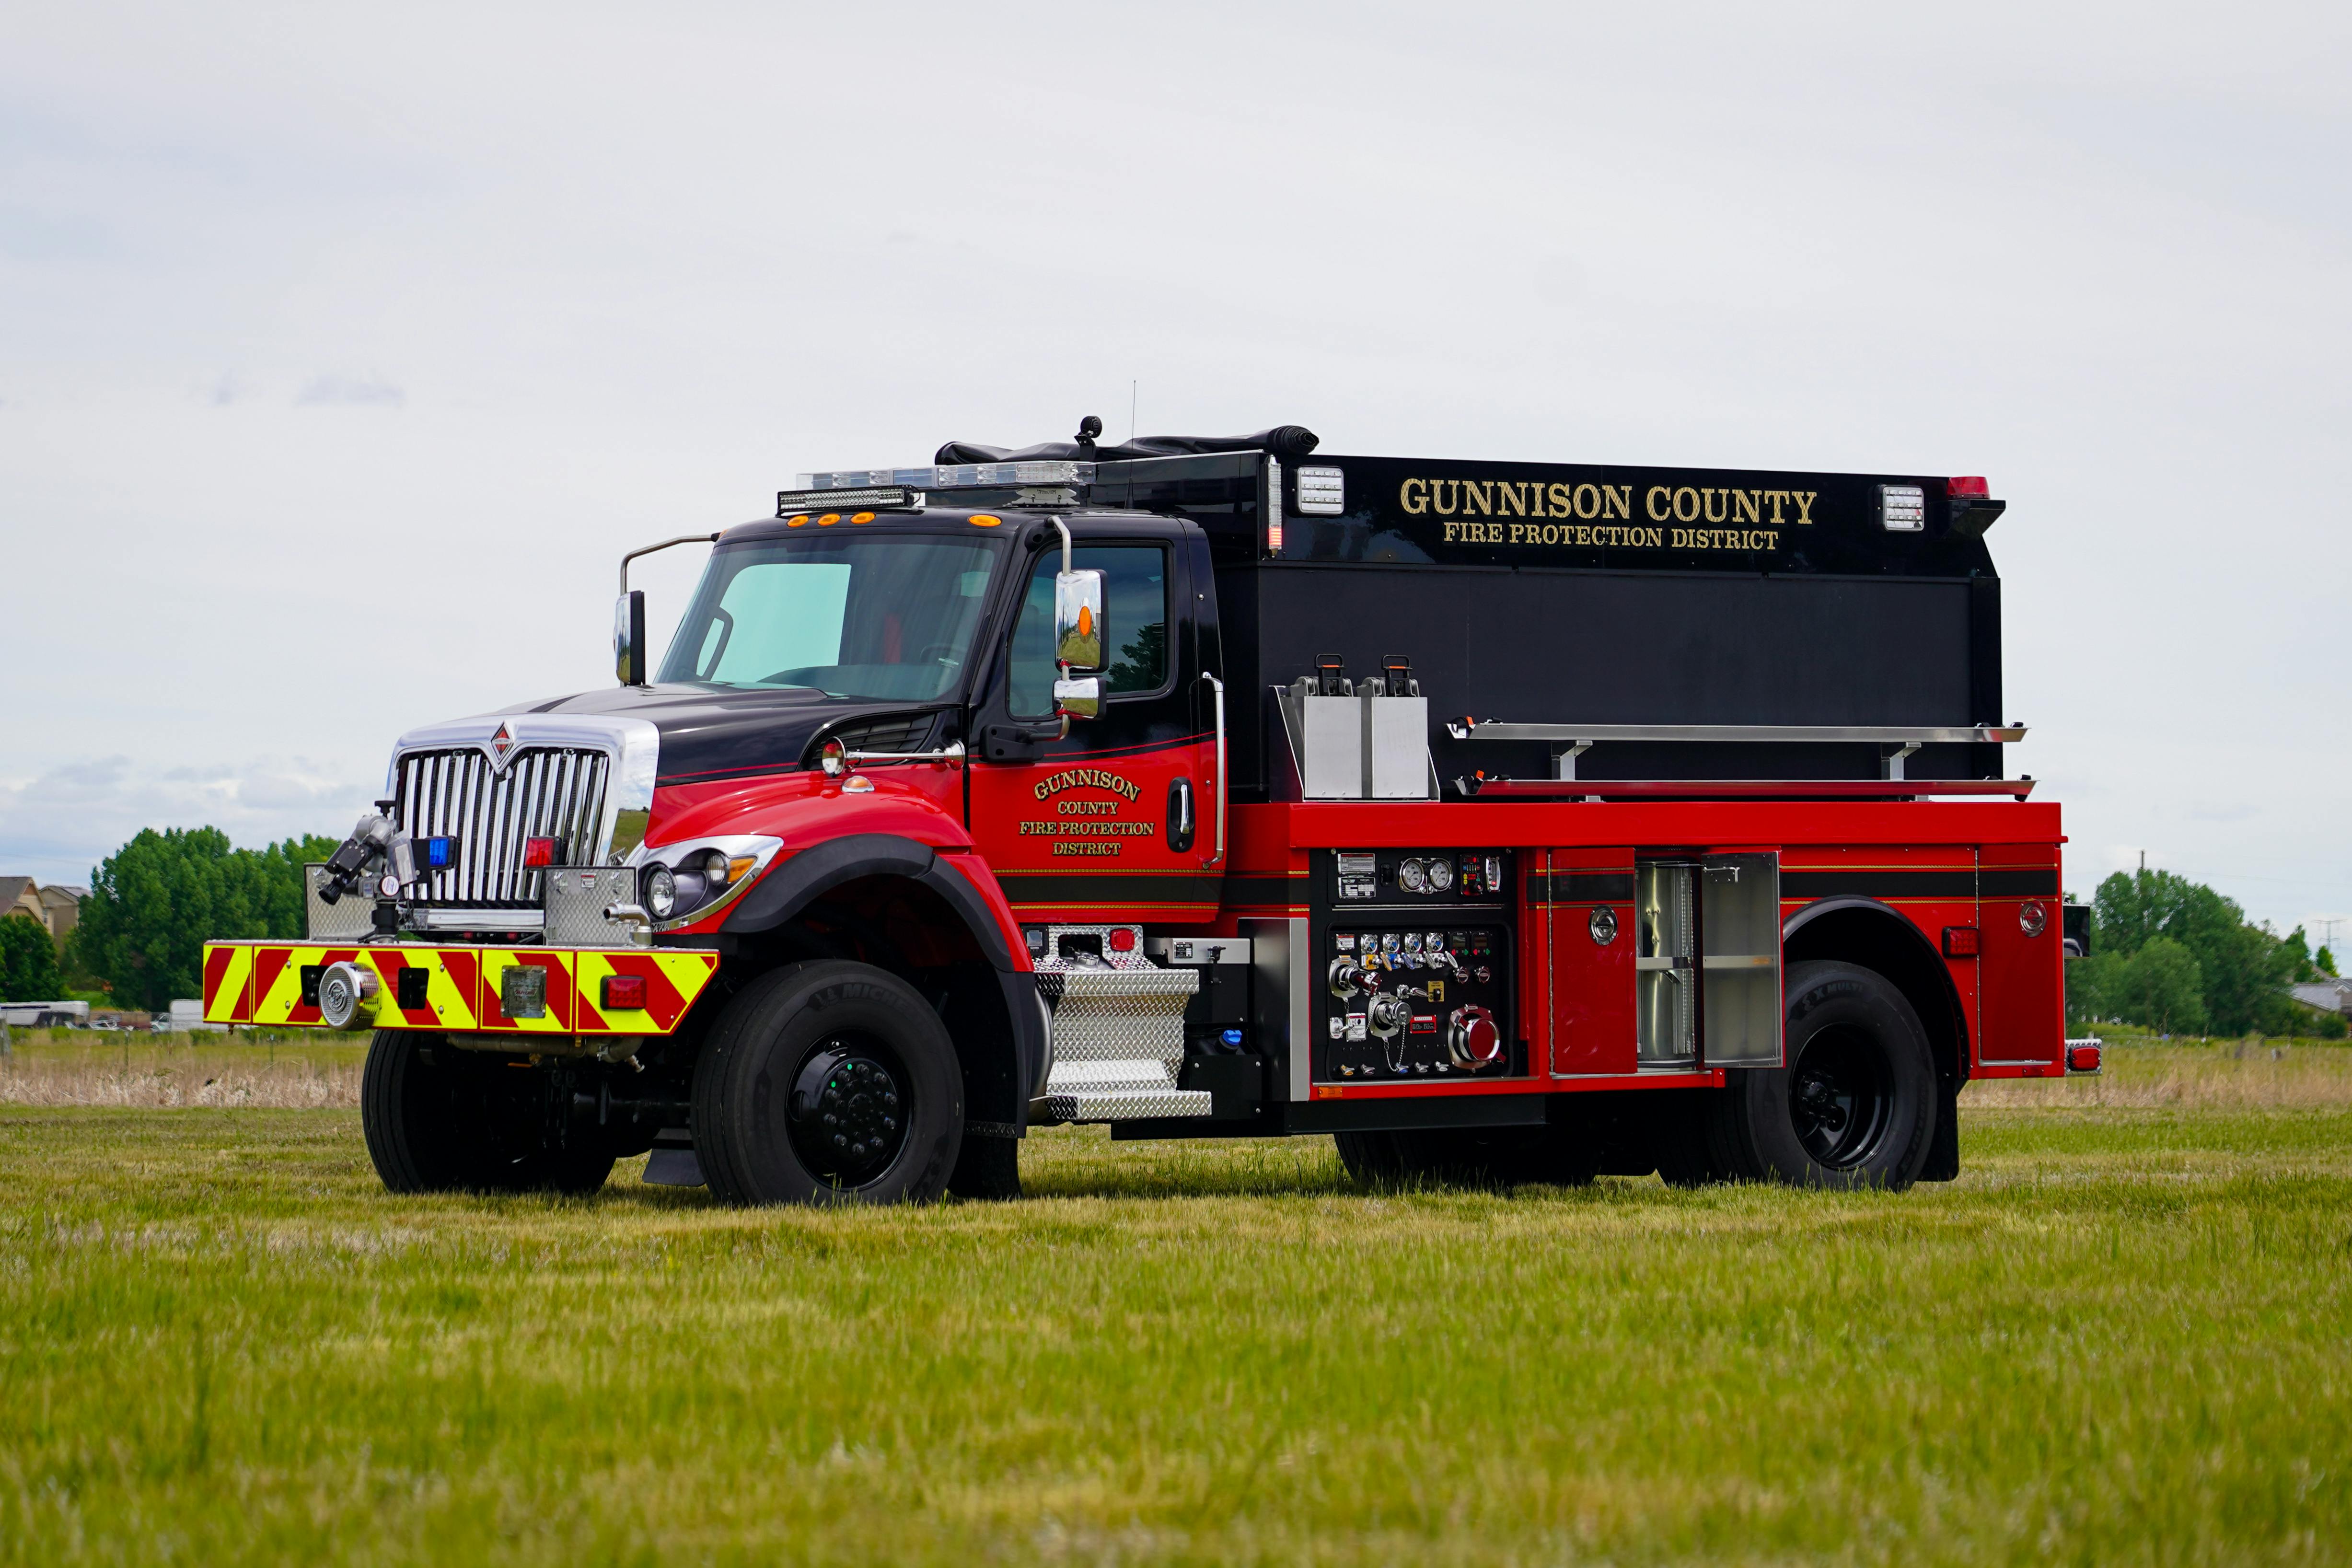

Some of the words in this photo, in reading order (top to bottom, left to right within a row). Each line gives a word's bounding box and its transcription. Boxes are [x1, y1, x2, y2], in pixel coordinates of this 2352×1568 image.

[1401, 478, 1633, 519] GUNNISON
[1646, 486, 1817, 524] COUNTY
[1444, 522, 1503, 543] FIRE
[1509, 524, 1663, 547] PROTECTION
[1671, 528, 1778, 550] DISTRICT
[1034, 769, 1140, 801] GUNNISON
[1057, 801, 1118, 814] COUNTY
[1020, 822, 1057, 835] FIRE
[1059, 822, 1154, 835] PROTECTION
[1053, 842, 1121, 855] DISTRICT
